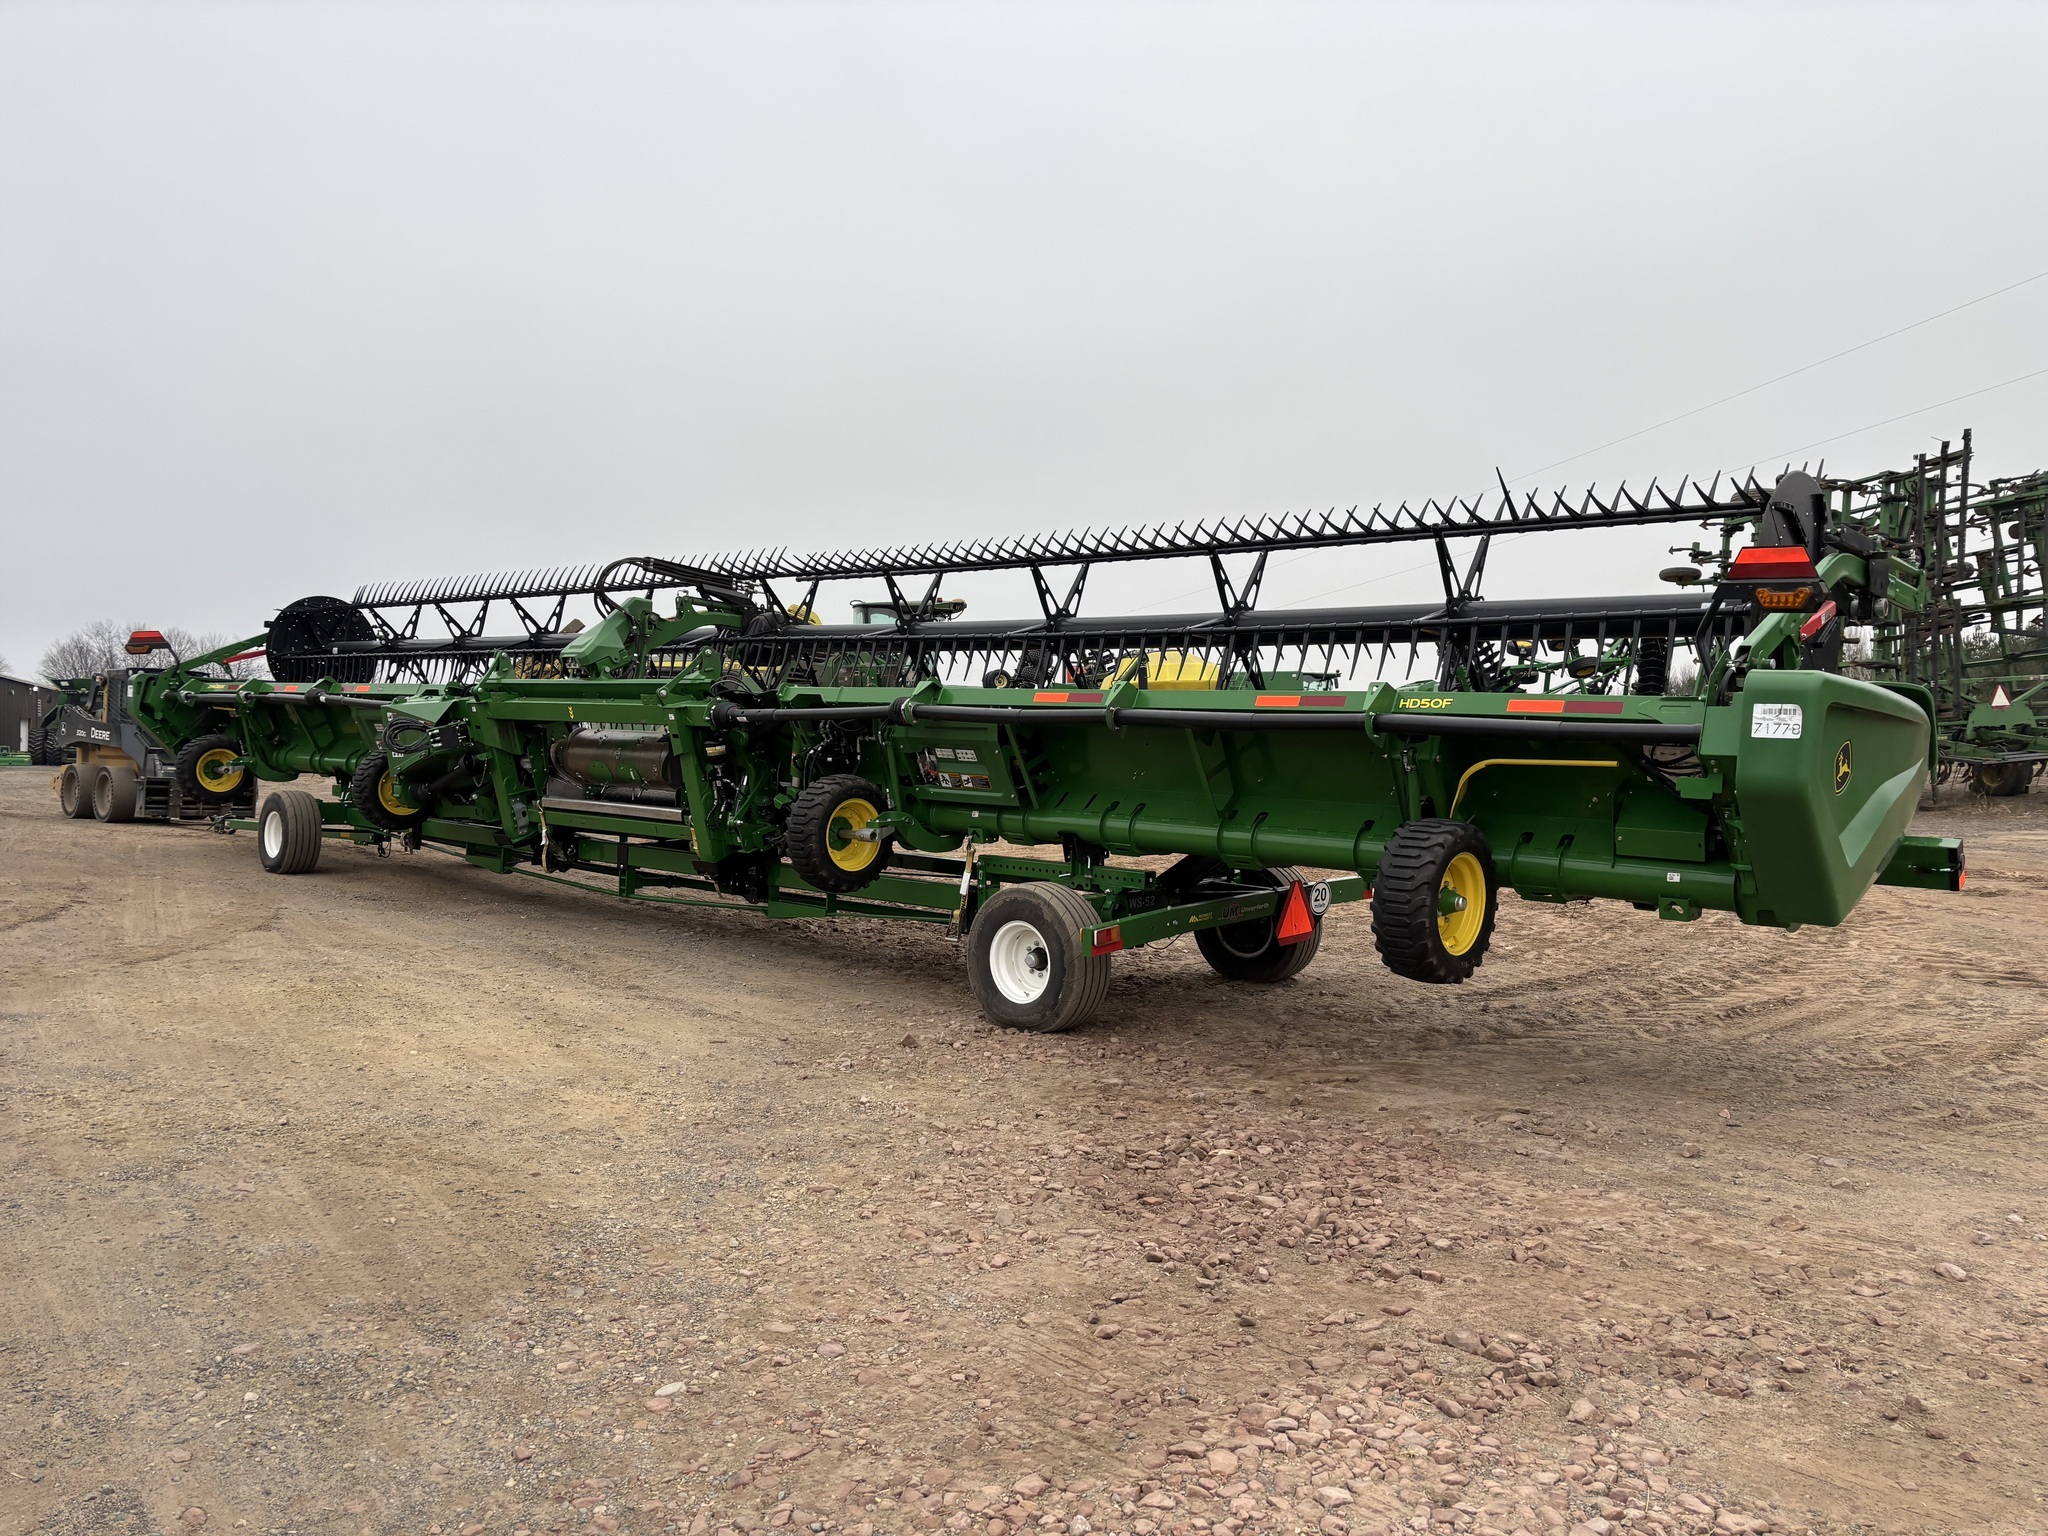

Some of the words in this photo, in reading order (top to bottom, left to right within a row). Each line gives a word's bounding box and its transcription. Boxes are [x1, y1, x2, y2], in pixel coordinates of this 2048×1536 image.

[1399, 698, 1454, 709] HD50F
[91, 726, 110, 740] DEERE
[1753, 722, 1801, 735] 71778
[1314, 888, 1327, 902] 20
